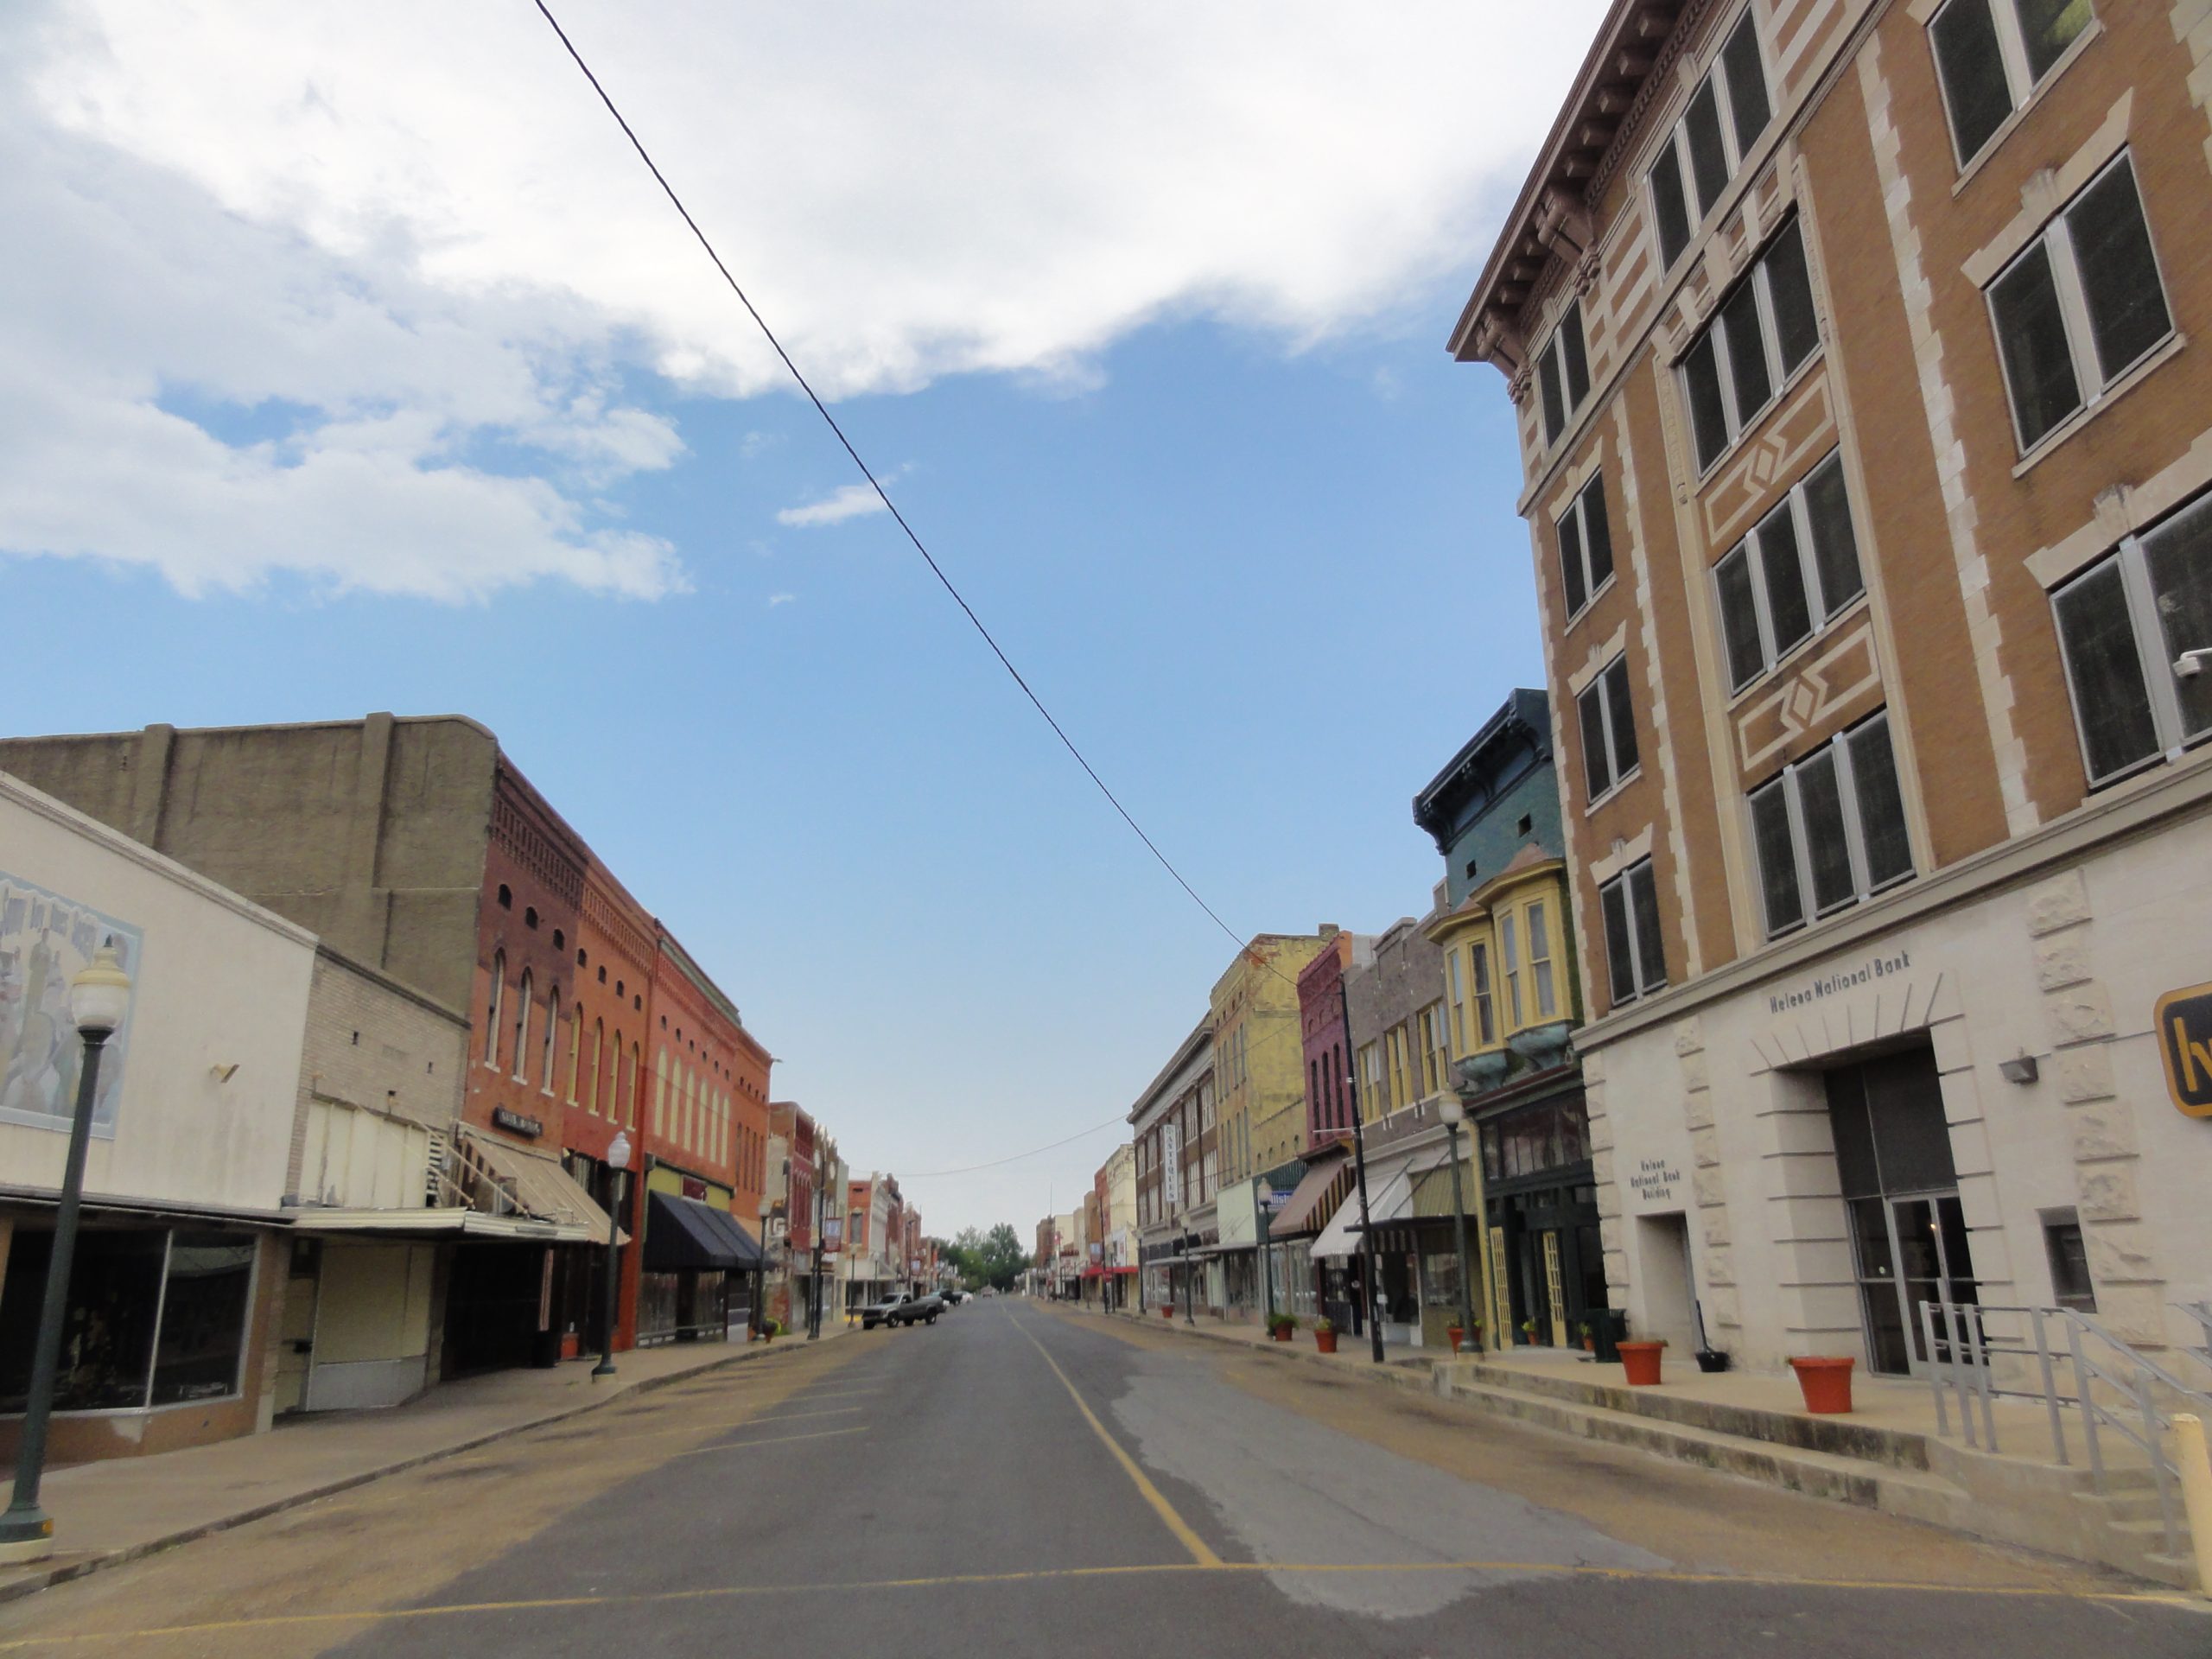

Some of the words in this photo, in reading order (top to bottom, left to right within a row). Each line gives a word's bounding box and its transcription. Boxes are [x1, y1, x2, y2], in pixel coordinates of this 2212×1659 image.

[1770, 988, 1812, 1014] Helena
[1815, 963, 1872, 999] National
[1875, 950, 1911, 977] Bank
